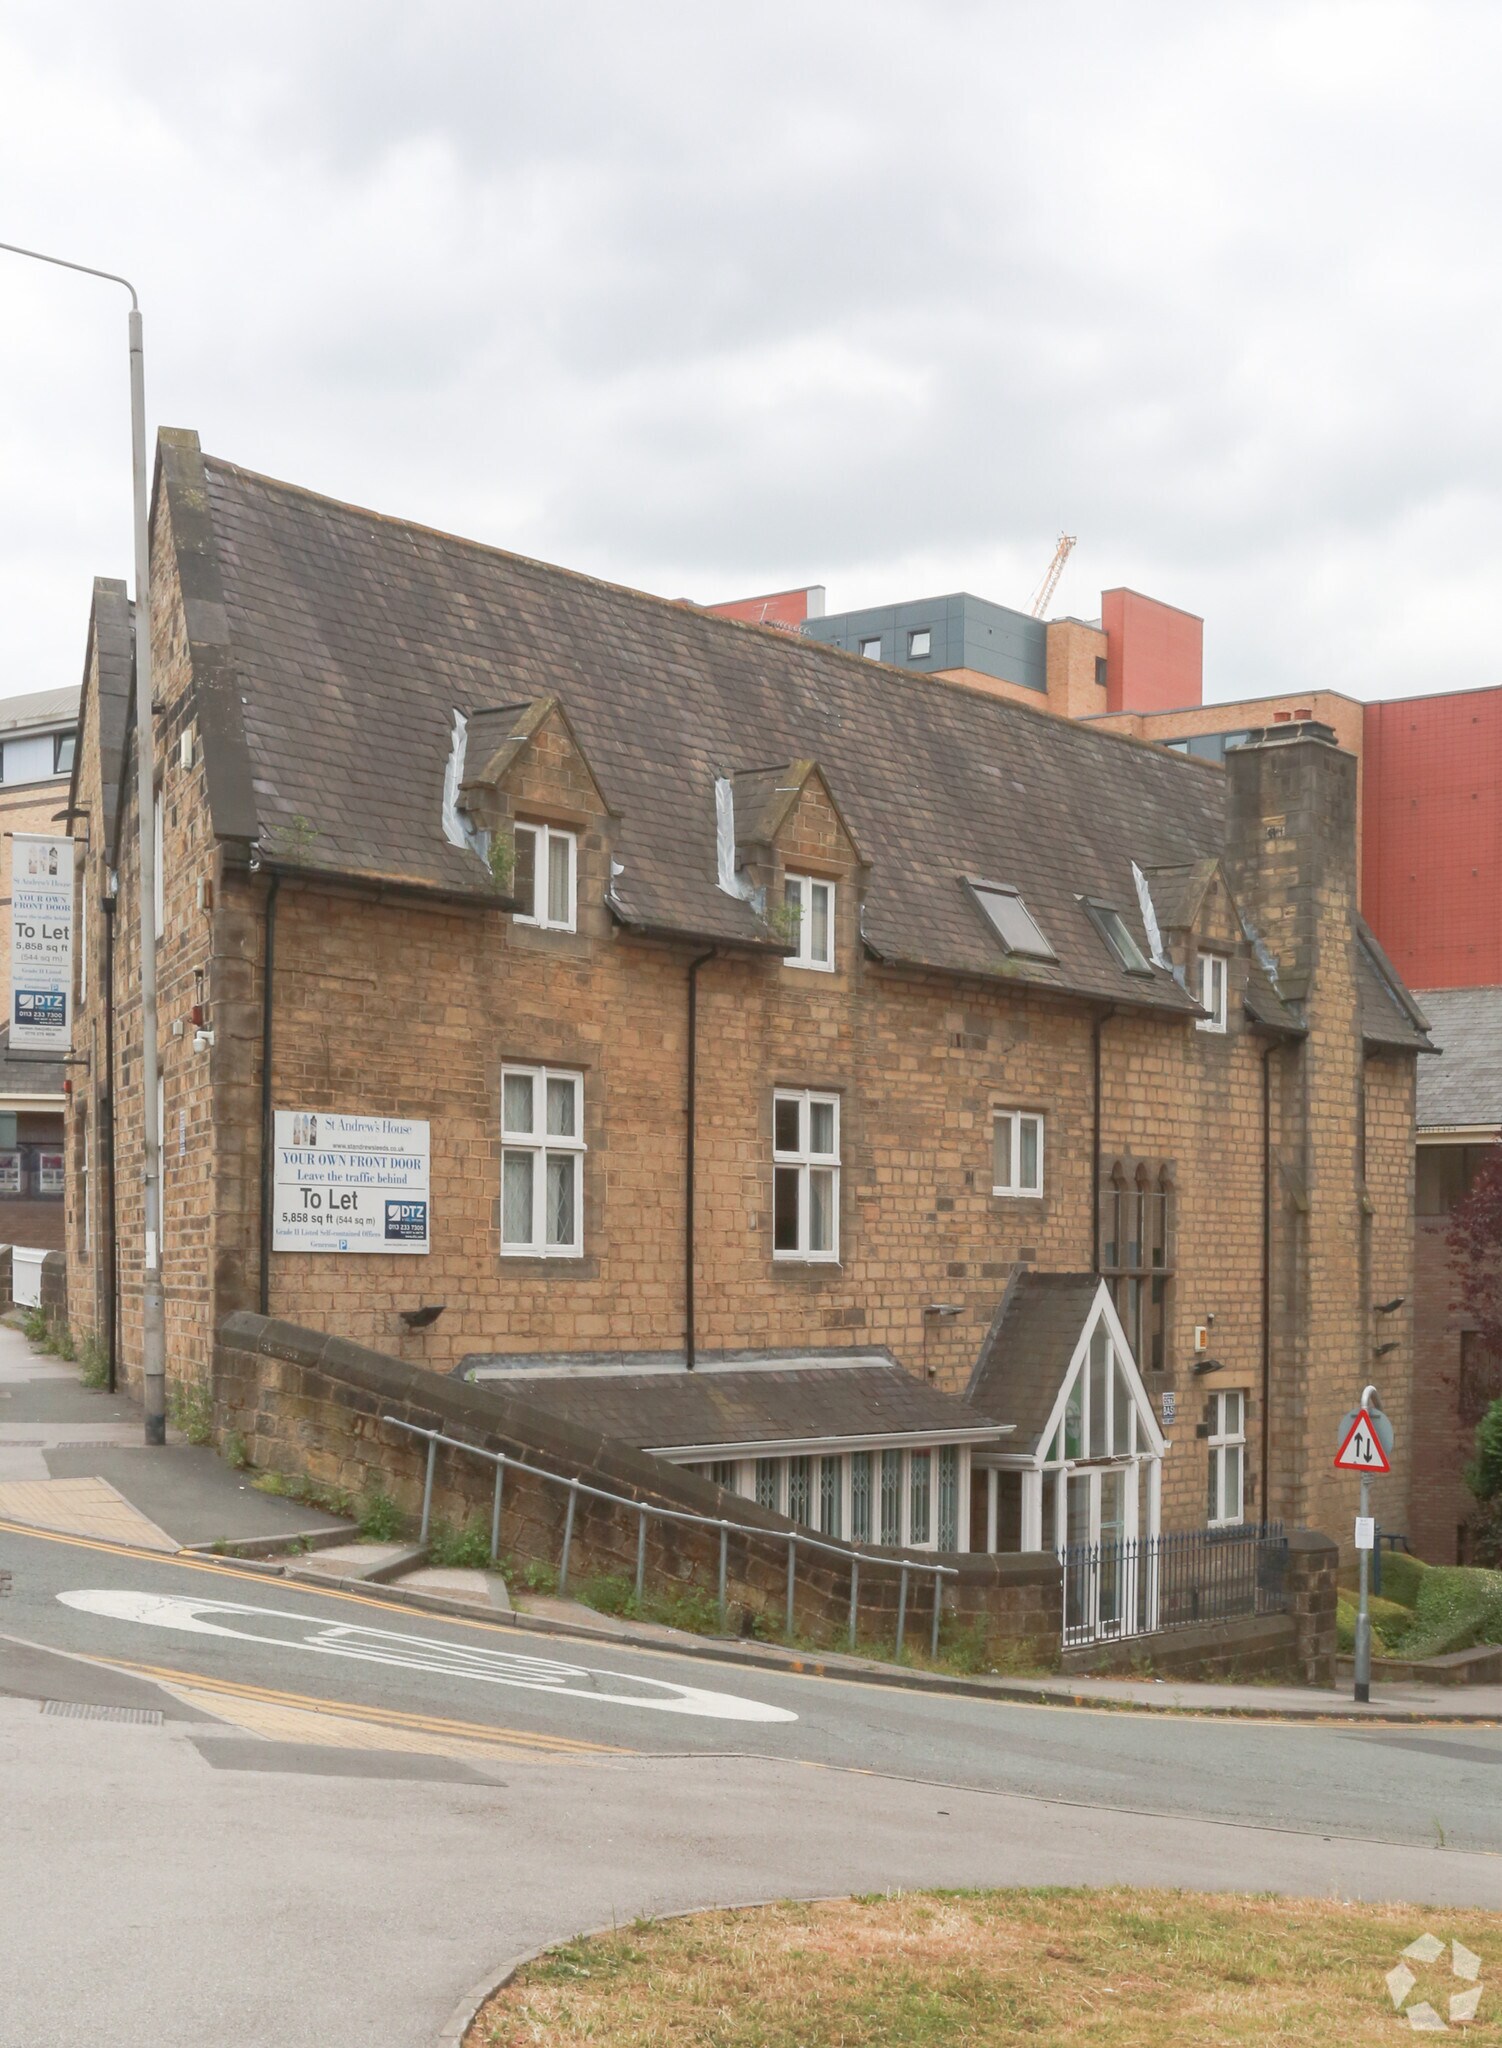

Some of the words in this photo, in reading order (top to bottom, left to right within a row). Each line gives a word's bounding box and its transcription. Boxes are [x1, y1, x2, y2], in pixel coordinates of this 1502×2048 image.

[19, 894, 43, 902] YOUR
[14, 902, 42, 910] FRONT
[15, 922, 35, 938] To
[43, 924, 69, 940] Let
[16, 942, 43, 951] 5,858
[46, 944, 58, 953] sq
[61, 944, 68, 952] ft
[21, 953, 39, 961] (544
[40, 955, 51, 963] sq
[52, 955, 63, 963] m)
[35, 995, 62, 1007] DTZ
[325, 1117, 335, 1130] St
[339, 1118, 380, 1133] Andrew's
[382, 1120, 412, 1135] House
[283, 1152, 315, 1165] YOUR
[318, 1153, 346, 1166] OWN
[350, 1155, 387, 1169] FRONT
[390, 1158, 421, 1170] DOOR
[297, 1169, 324, 1181] Leave
[327, 1170, 342, 1182] the
[345, 1171, 374, 1183] traffic
[377, 1173, 407, 1184] behind
[300, 1187, 322, 1209] To
[329, 1188, 358, 1210] Let
[401, 1205, 424, 1218] DTZ
[282, 1212, 308, 1223] 5,858
[311, 1215, 323, 1225] sq
[326, 1213, 333, 1224] ft
[336, 1216, 352, 1225] (544
[354, 1217, 364, 1226] sq
[365, 1217, 376, 1226] m)
[320, 1229, 361, 1237] Self-contained
[303, 1626, 590, 1684] 20
